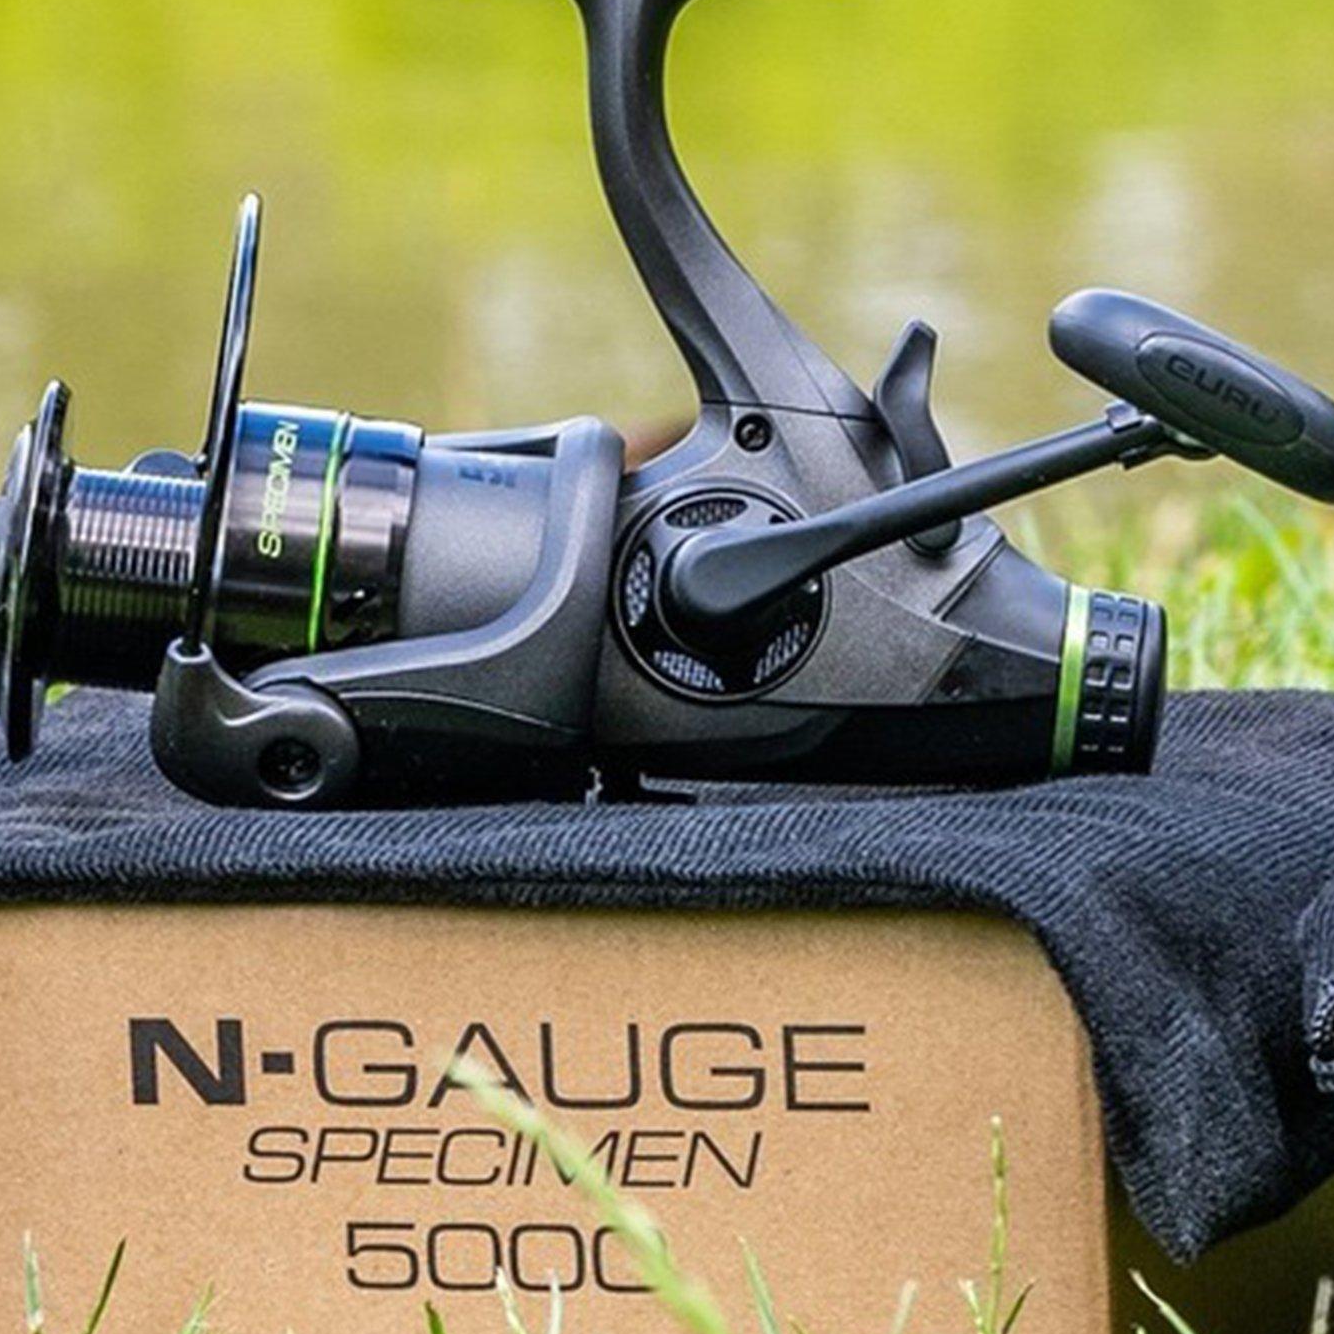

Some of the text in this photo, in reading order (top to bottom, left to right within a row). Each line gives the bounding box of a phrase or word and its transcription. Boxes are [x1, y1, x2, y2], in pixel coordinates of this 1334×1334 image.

[258, 420, 299, 558] SPECIMEN
[129, 1017, 871, 1113] N-GAUGE
[243, 1126, 763, 1189] SPECIMEN
